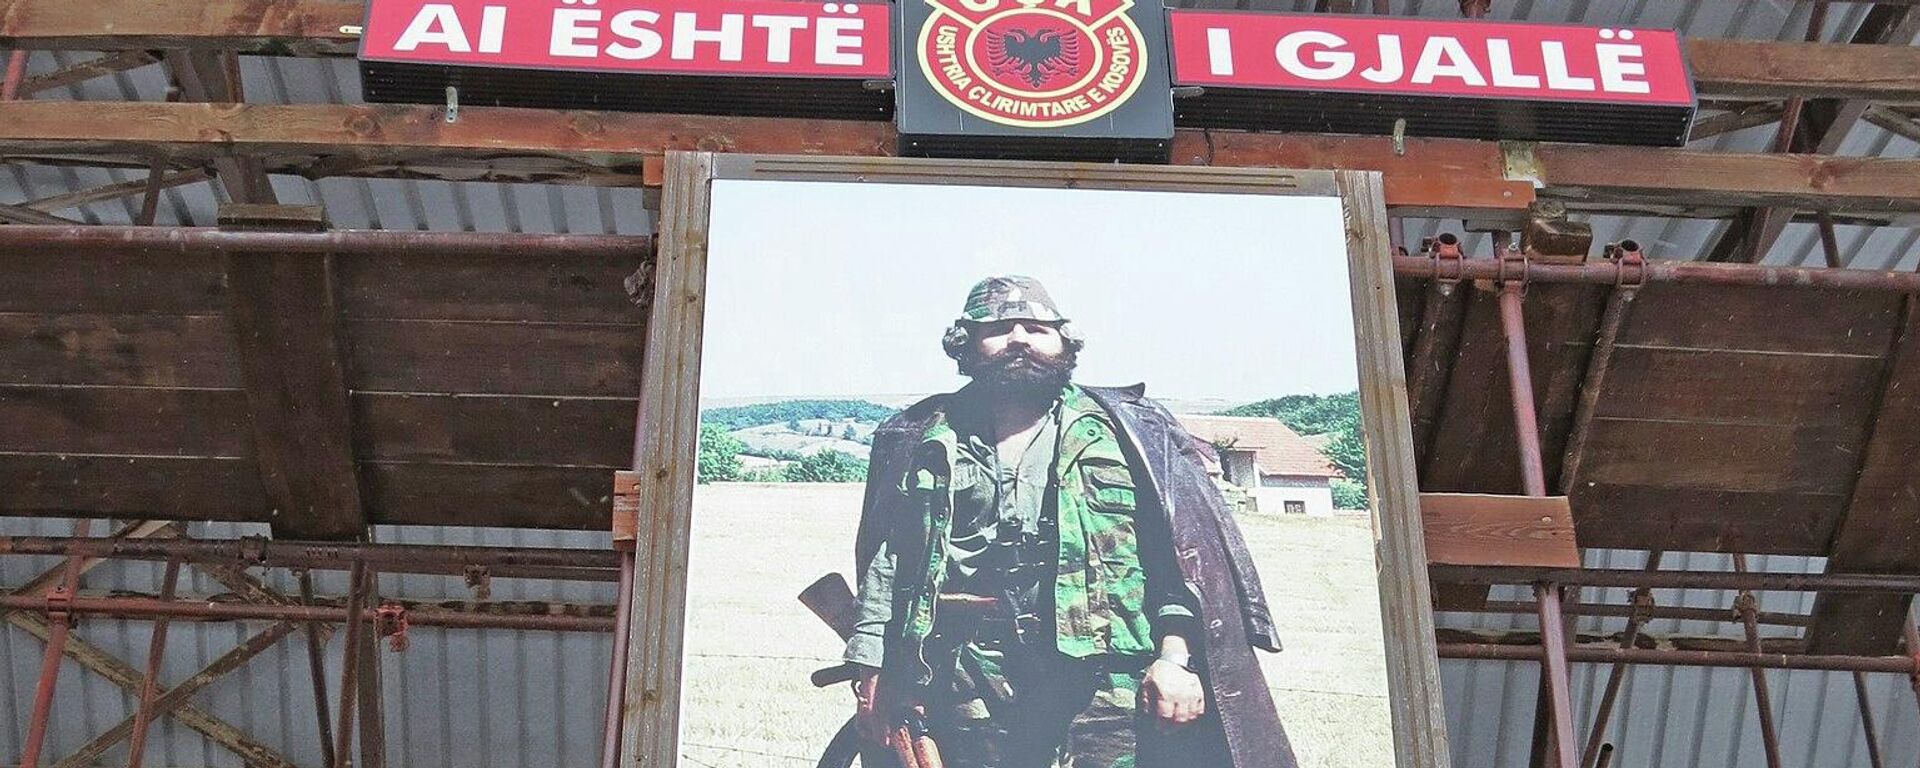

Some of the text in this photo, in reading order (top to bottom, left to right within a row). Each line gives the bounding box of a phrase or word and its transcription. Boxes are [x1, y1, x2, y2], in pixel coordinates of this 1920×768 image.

[393, 0, 866, 66] AI ËSHTË
[1207, 27, 1652, 94] I GJALLË
[935, 25, 1131, 117] USHTRIA ÇLIRIMTARE E KOSOVËS
